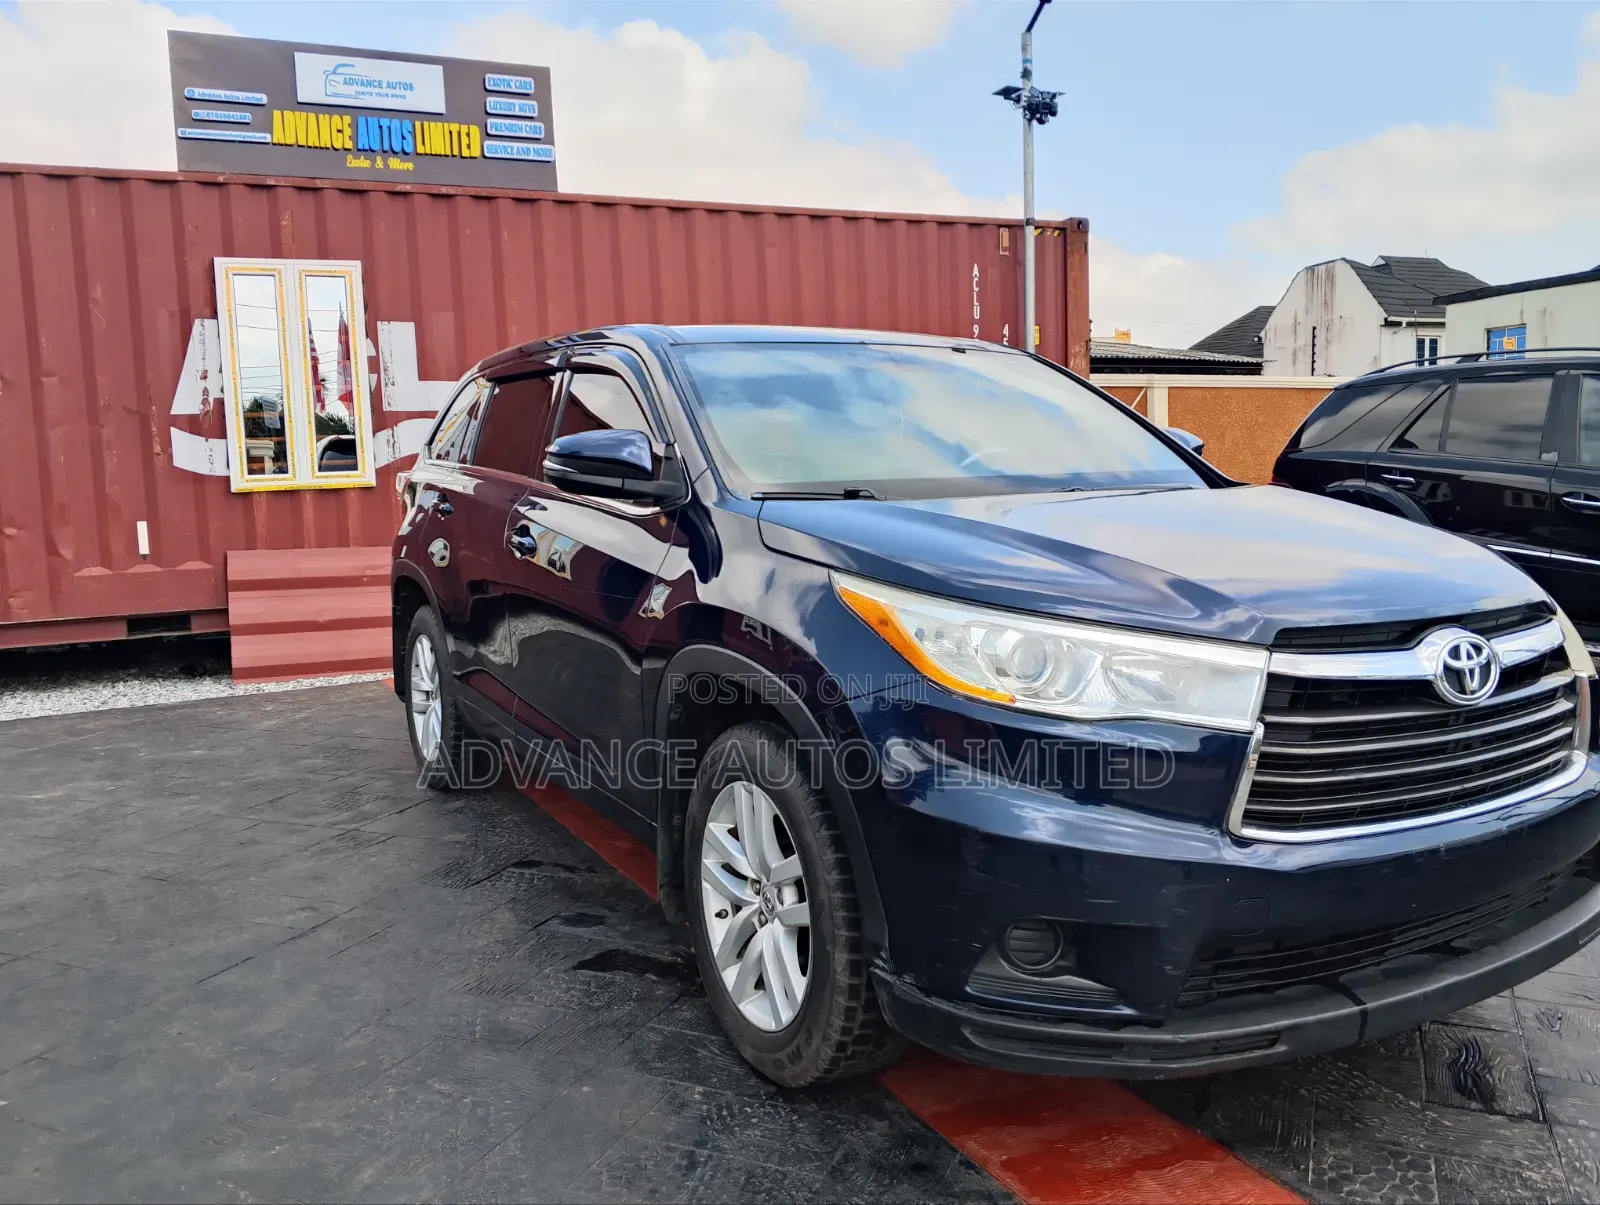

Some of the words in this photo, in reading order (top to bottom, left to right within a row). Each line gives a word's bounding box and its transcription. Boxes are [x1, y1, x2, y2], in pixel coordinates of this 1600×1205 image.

[343, 77, 383, 89] ADVANCE
[386, 80, 414, 92] AUTOS
[487, 77, 513, 89] EXOTIC
[514, 79, 533, 91] CARS
[241, 95, 263, 103] Limited
[489, 100, 516, 111] LUXURY
[272, 109, 353, 150] ADVANCE
[356, 116, 413, 154] AUTOS
[414, 120, 481, 158] LIMITED
[525, 124, 543, 136] CARS
[486, 144, 515, 156] SERVICE
[516, 146, 531, 157] AND
[533, 147, 554, 158] MORE
[375, 155, 384, 169] &
[387, 156, 414, 170] More
